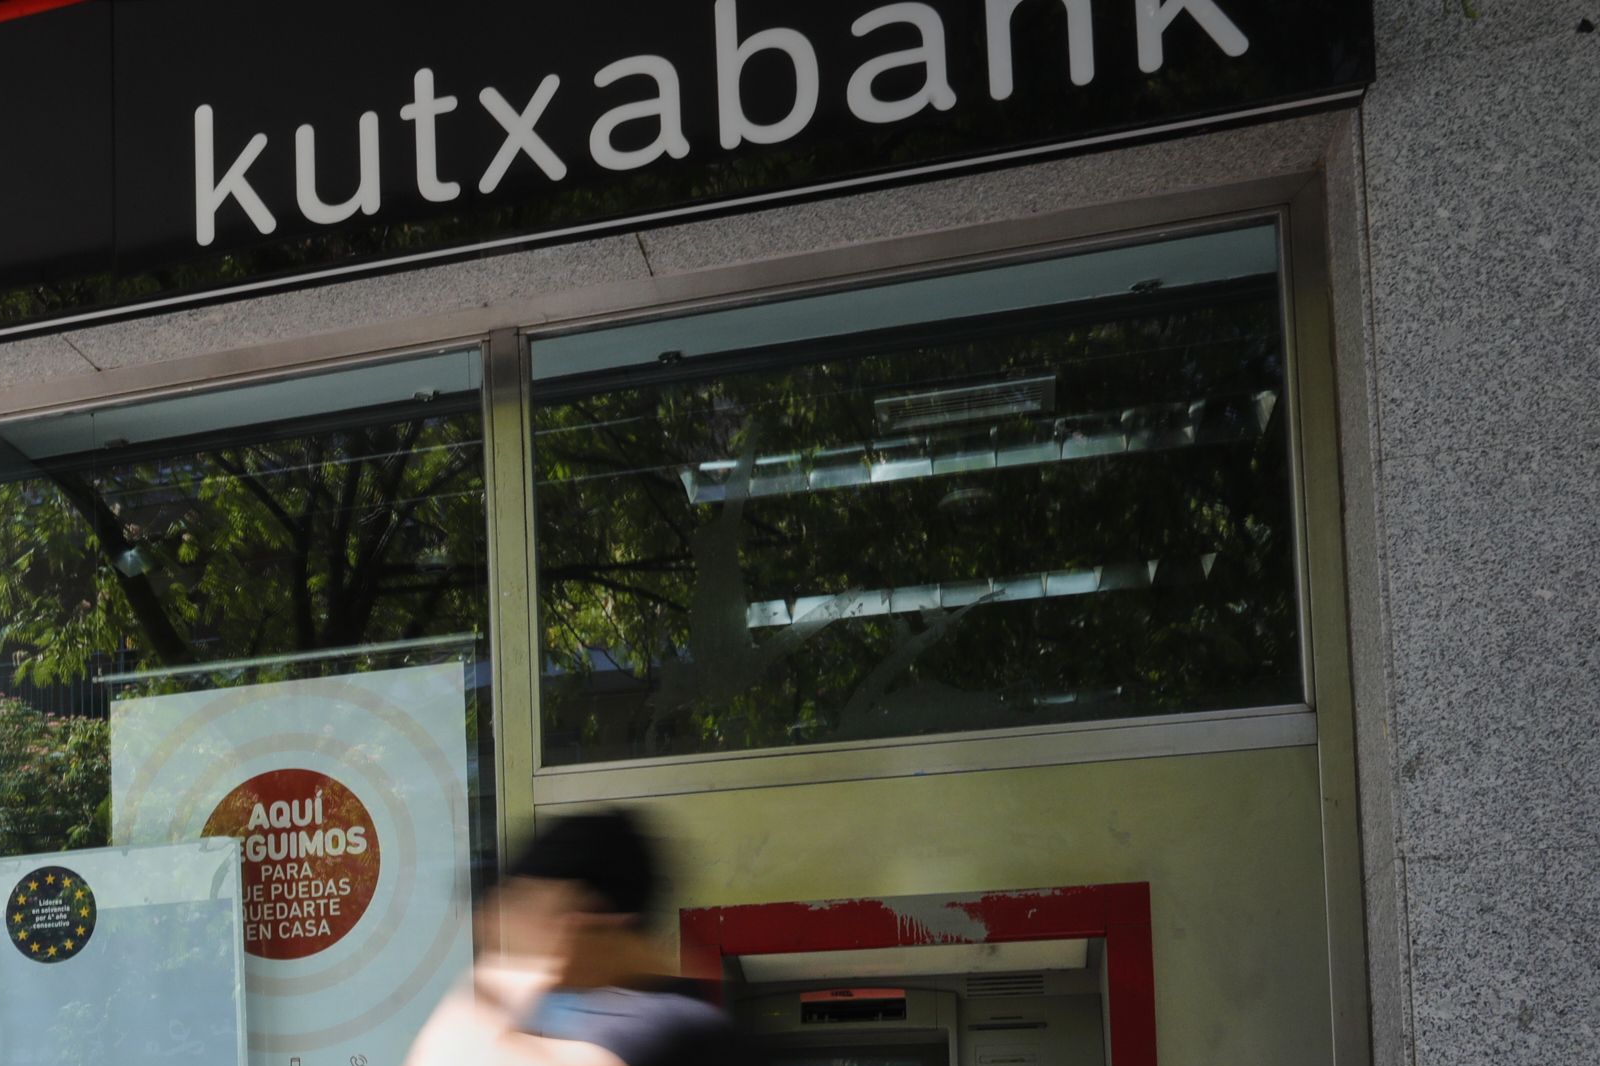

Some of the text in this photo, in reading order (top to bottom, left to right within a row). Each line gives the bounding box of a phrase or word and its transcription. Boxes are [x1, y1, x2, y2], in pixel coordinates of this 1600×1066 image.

[248, 789, 323, 831] AQUÍ
[240, 826, 368, 863] GUIMOS
[261, 862, 313, 882] PARA
[271, 878, 351, 900] PUEDAS
[35, 915, 46, 923] por
[55, 912, 67, 920] año
[41, 905, 70, 914] solvencia
[33, 920, 70, 929] consecutivo
[246, 918, 331, 941] EN CASA
